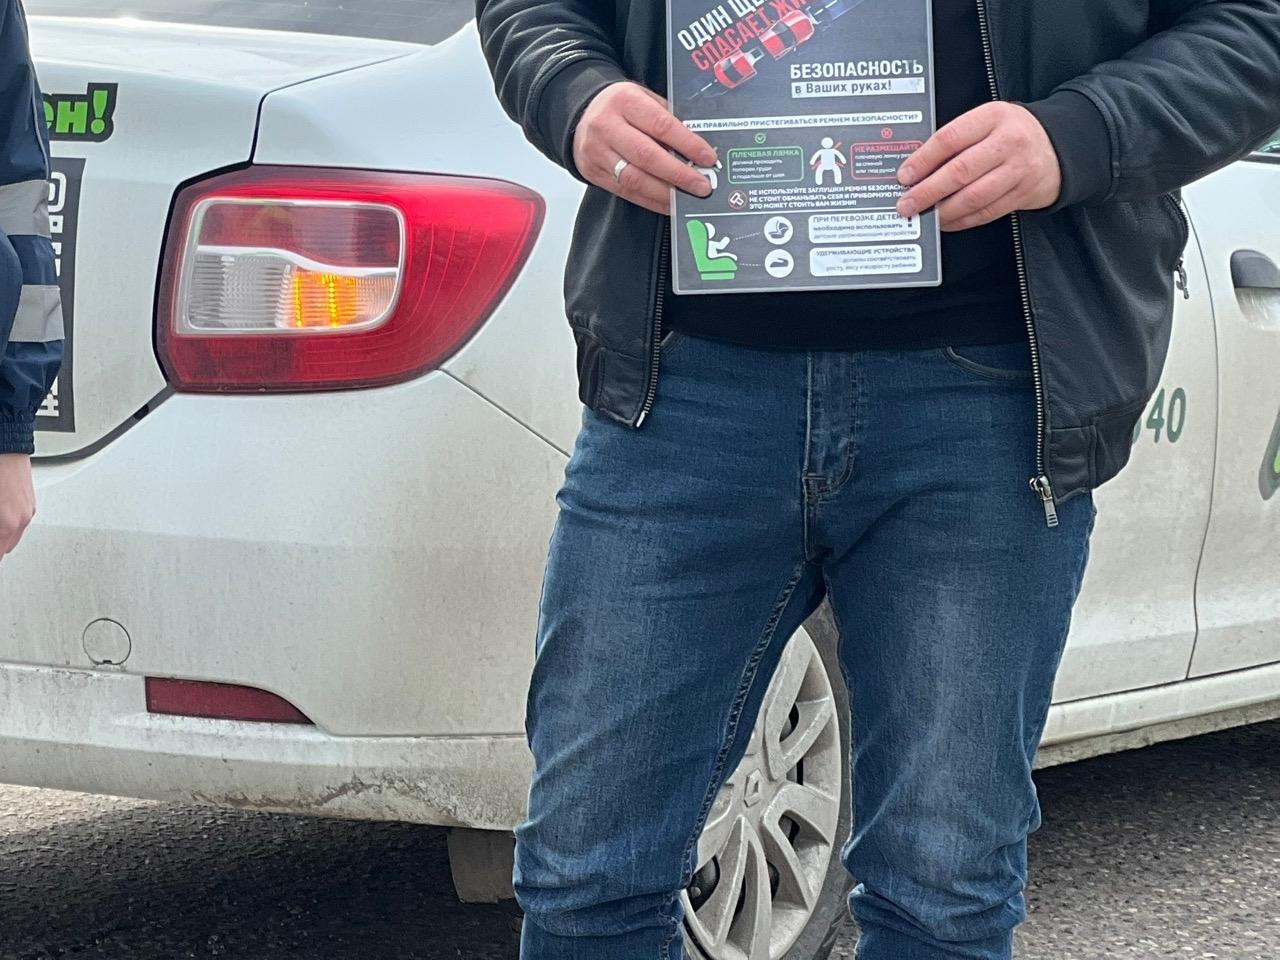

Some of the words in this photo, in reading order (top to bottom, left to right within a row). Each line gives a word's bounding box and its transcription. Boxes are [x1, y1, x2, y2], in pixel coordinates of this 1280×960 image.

[677, 5, 733, 51] ОДИН
[690, 9, 773, 71] СПАСАЕТ
[790, 59, 924, 80] БЕЗОПАСНОСТЬ
[794, 84, 802, 94] в
[806, 81, 847, 94] Ваших
[851, 79, 892, 95] руках!
[703, 120, 749, 128] ПРАВИЛЬНО
[750, 118, 818, 127] ПРИСТЕГИВАТЬСЯ
[851, 114, 918, 122] БЕЗОПАСНОСТИ?
[731, 150, 772, 158] ПЛЕЧЕВАЯ
[758, 187, 807, 195] ИСПОЛЬЗУЙТЕ
[830, 214, 875, 222] ПЕРЕВОЗКЕ
[1133, 387, 1187, 444] 40
